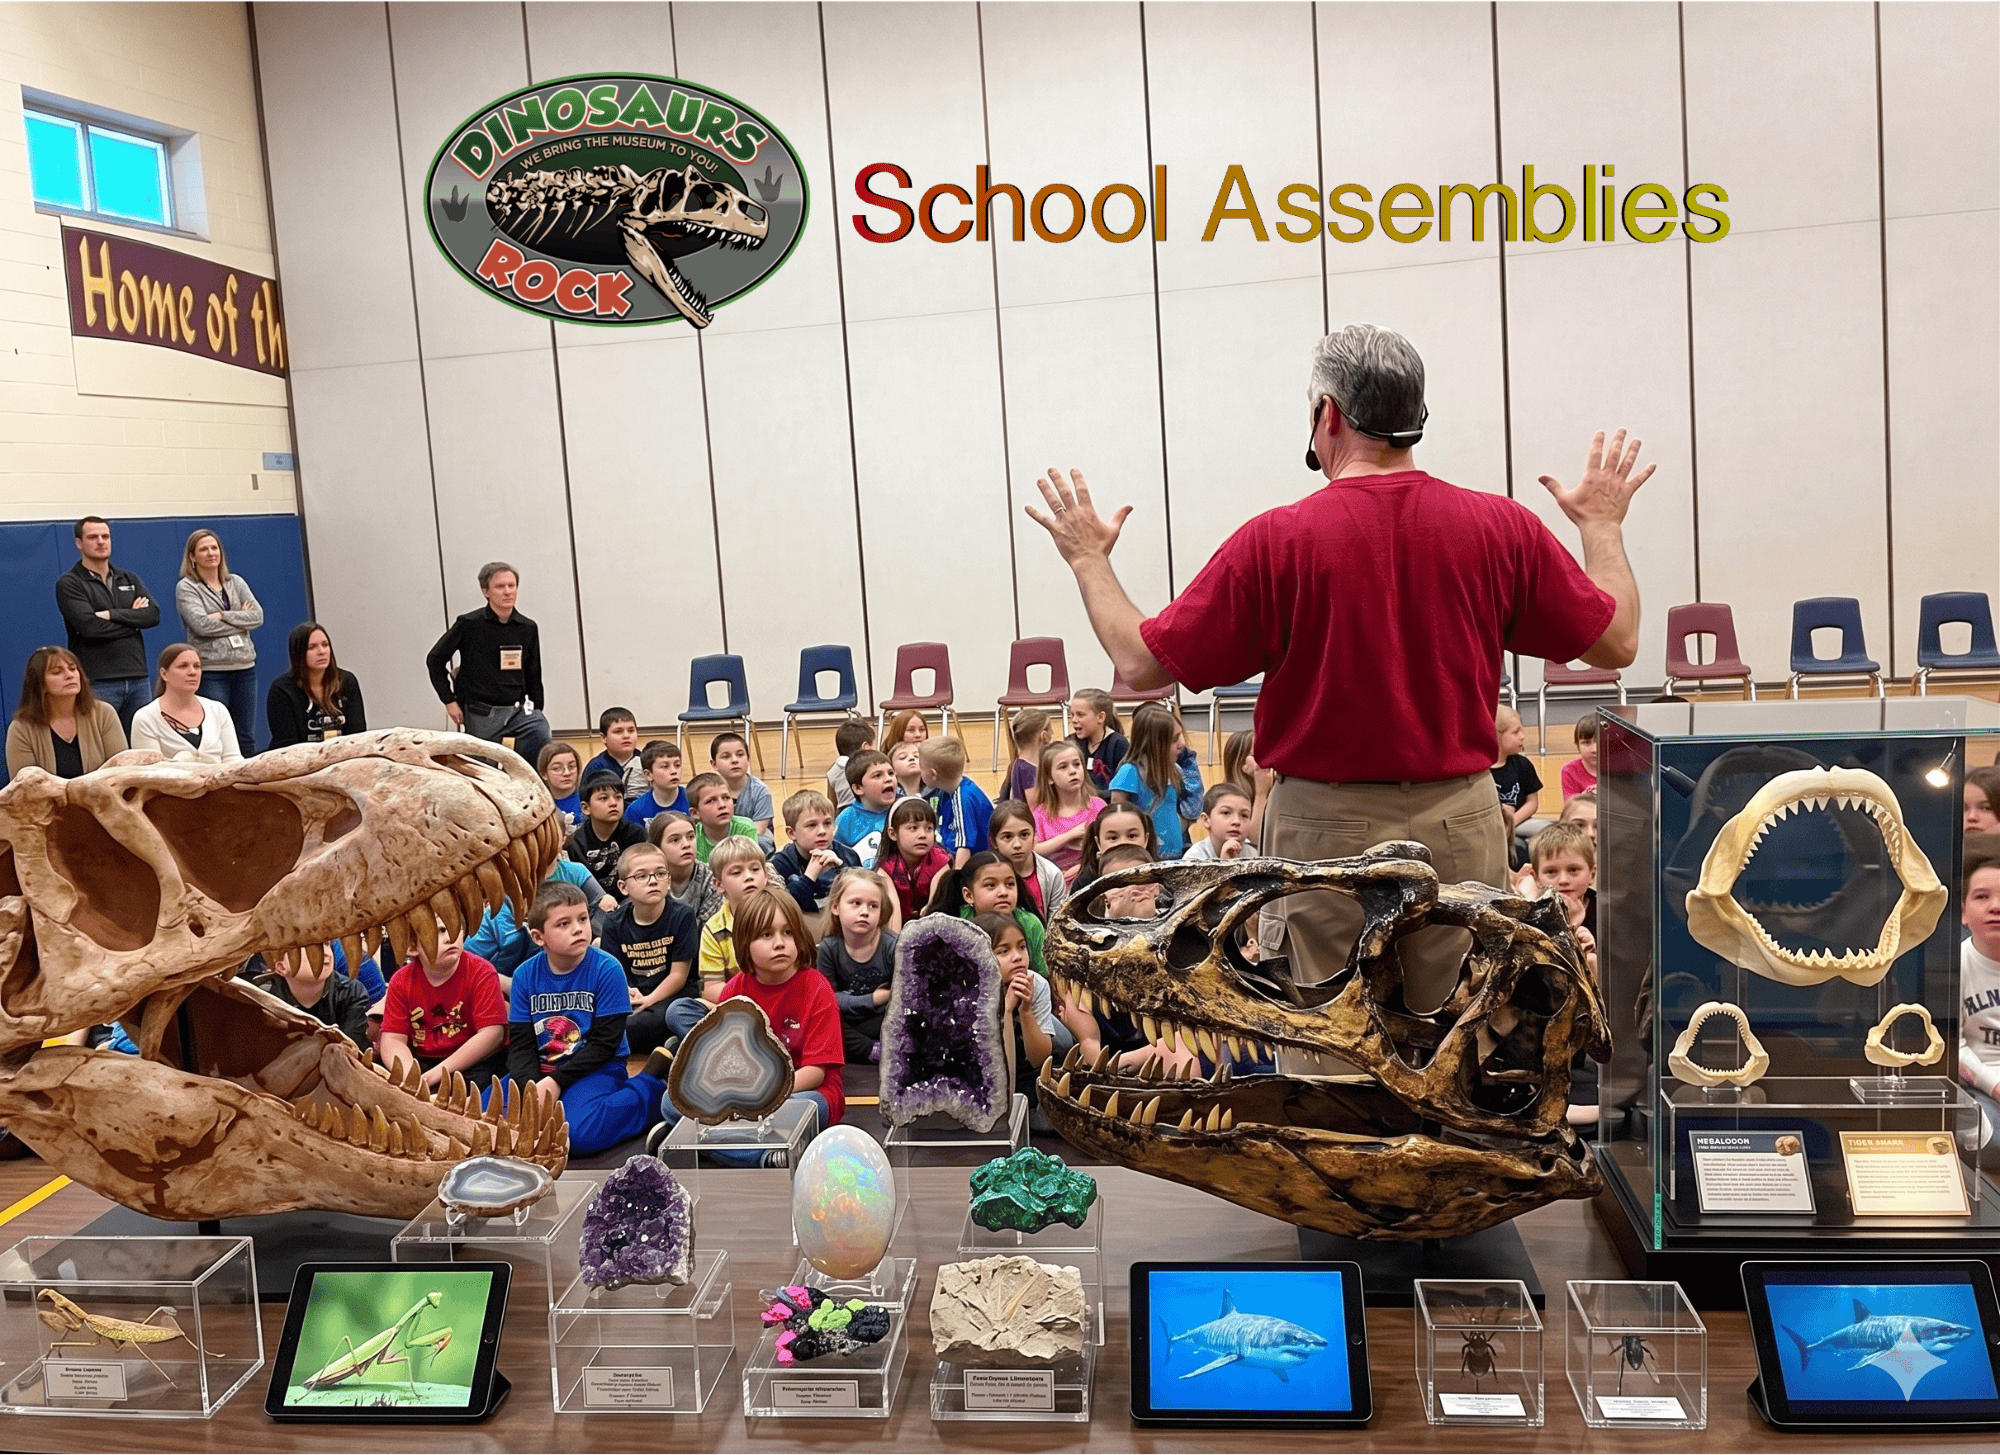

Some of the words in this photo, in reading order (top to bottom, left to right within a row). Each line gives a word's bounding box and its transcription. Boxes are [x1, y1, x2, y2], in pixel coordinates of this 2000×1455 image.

[79, 235, 197, 346] Home
[206, 273, 239, 358] of
[251, 281, 285, 369] th
